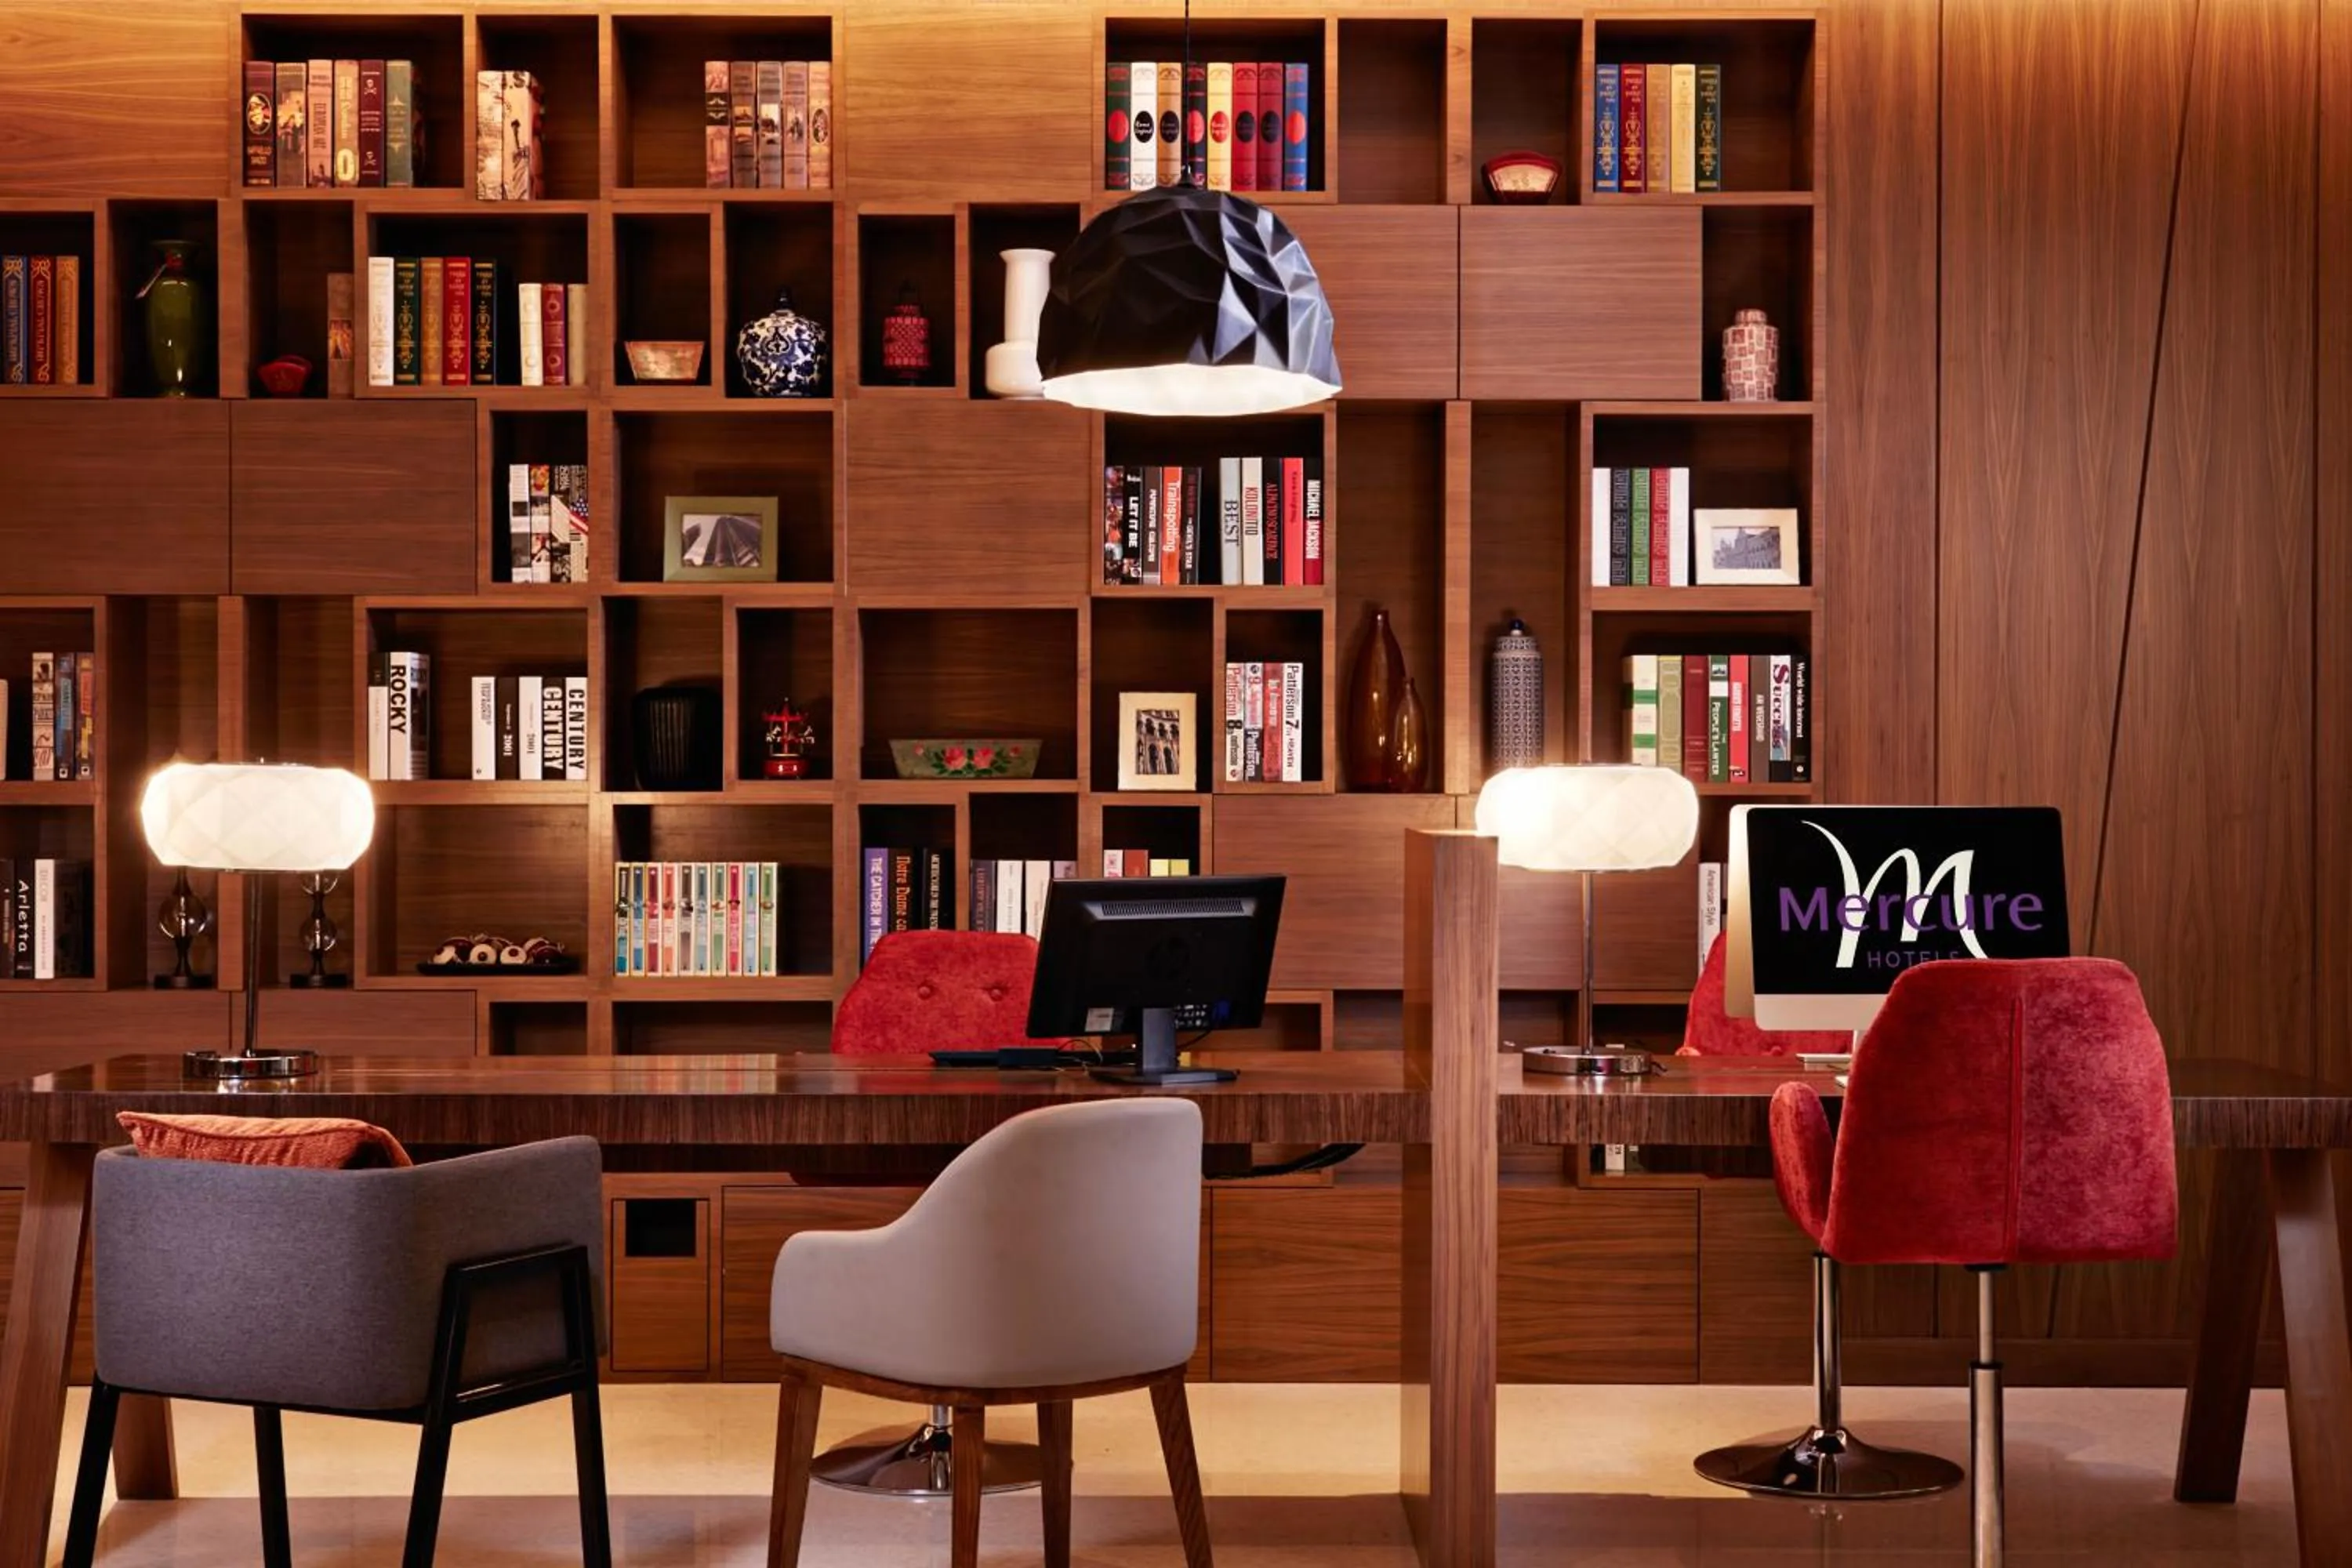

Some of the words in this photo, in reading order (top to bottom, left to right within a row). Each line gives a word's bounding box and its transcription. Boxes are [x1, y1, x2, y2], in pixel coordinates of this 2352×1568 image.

[1128, 496, 1139, 517] LET
[1163, 480, 1181, 553] Trainspotting
[1306, 479, 1321, 518] MICHAEL
[1128, 518, 1139, 531] IT
[1128, 532, 1139, 548] BE
[1225, 500, 1240, 547] BEST
[1305, 520, 1319, 559] JACKSON
[1285, 664, 1300, 718] Patterson
[1796, 662, 1805, 688] World
[390, 665, 407, 735] ROCKY
[503, 734, 513, 757] 2001
[526, 733, 535, 754] 2001
[543, 686, 564, 770] CENTURY
[568, 688, 585, 770] CENTURY
[871, 857, 883, 874] THE
[895, 855, 910, 884] Notre
[18, 879, 31, 953] Arletta
[895, 887, 910, 916] Dame
[1779, 885, 2045, 933] Mercure
